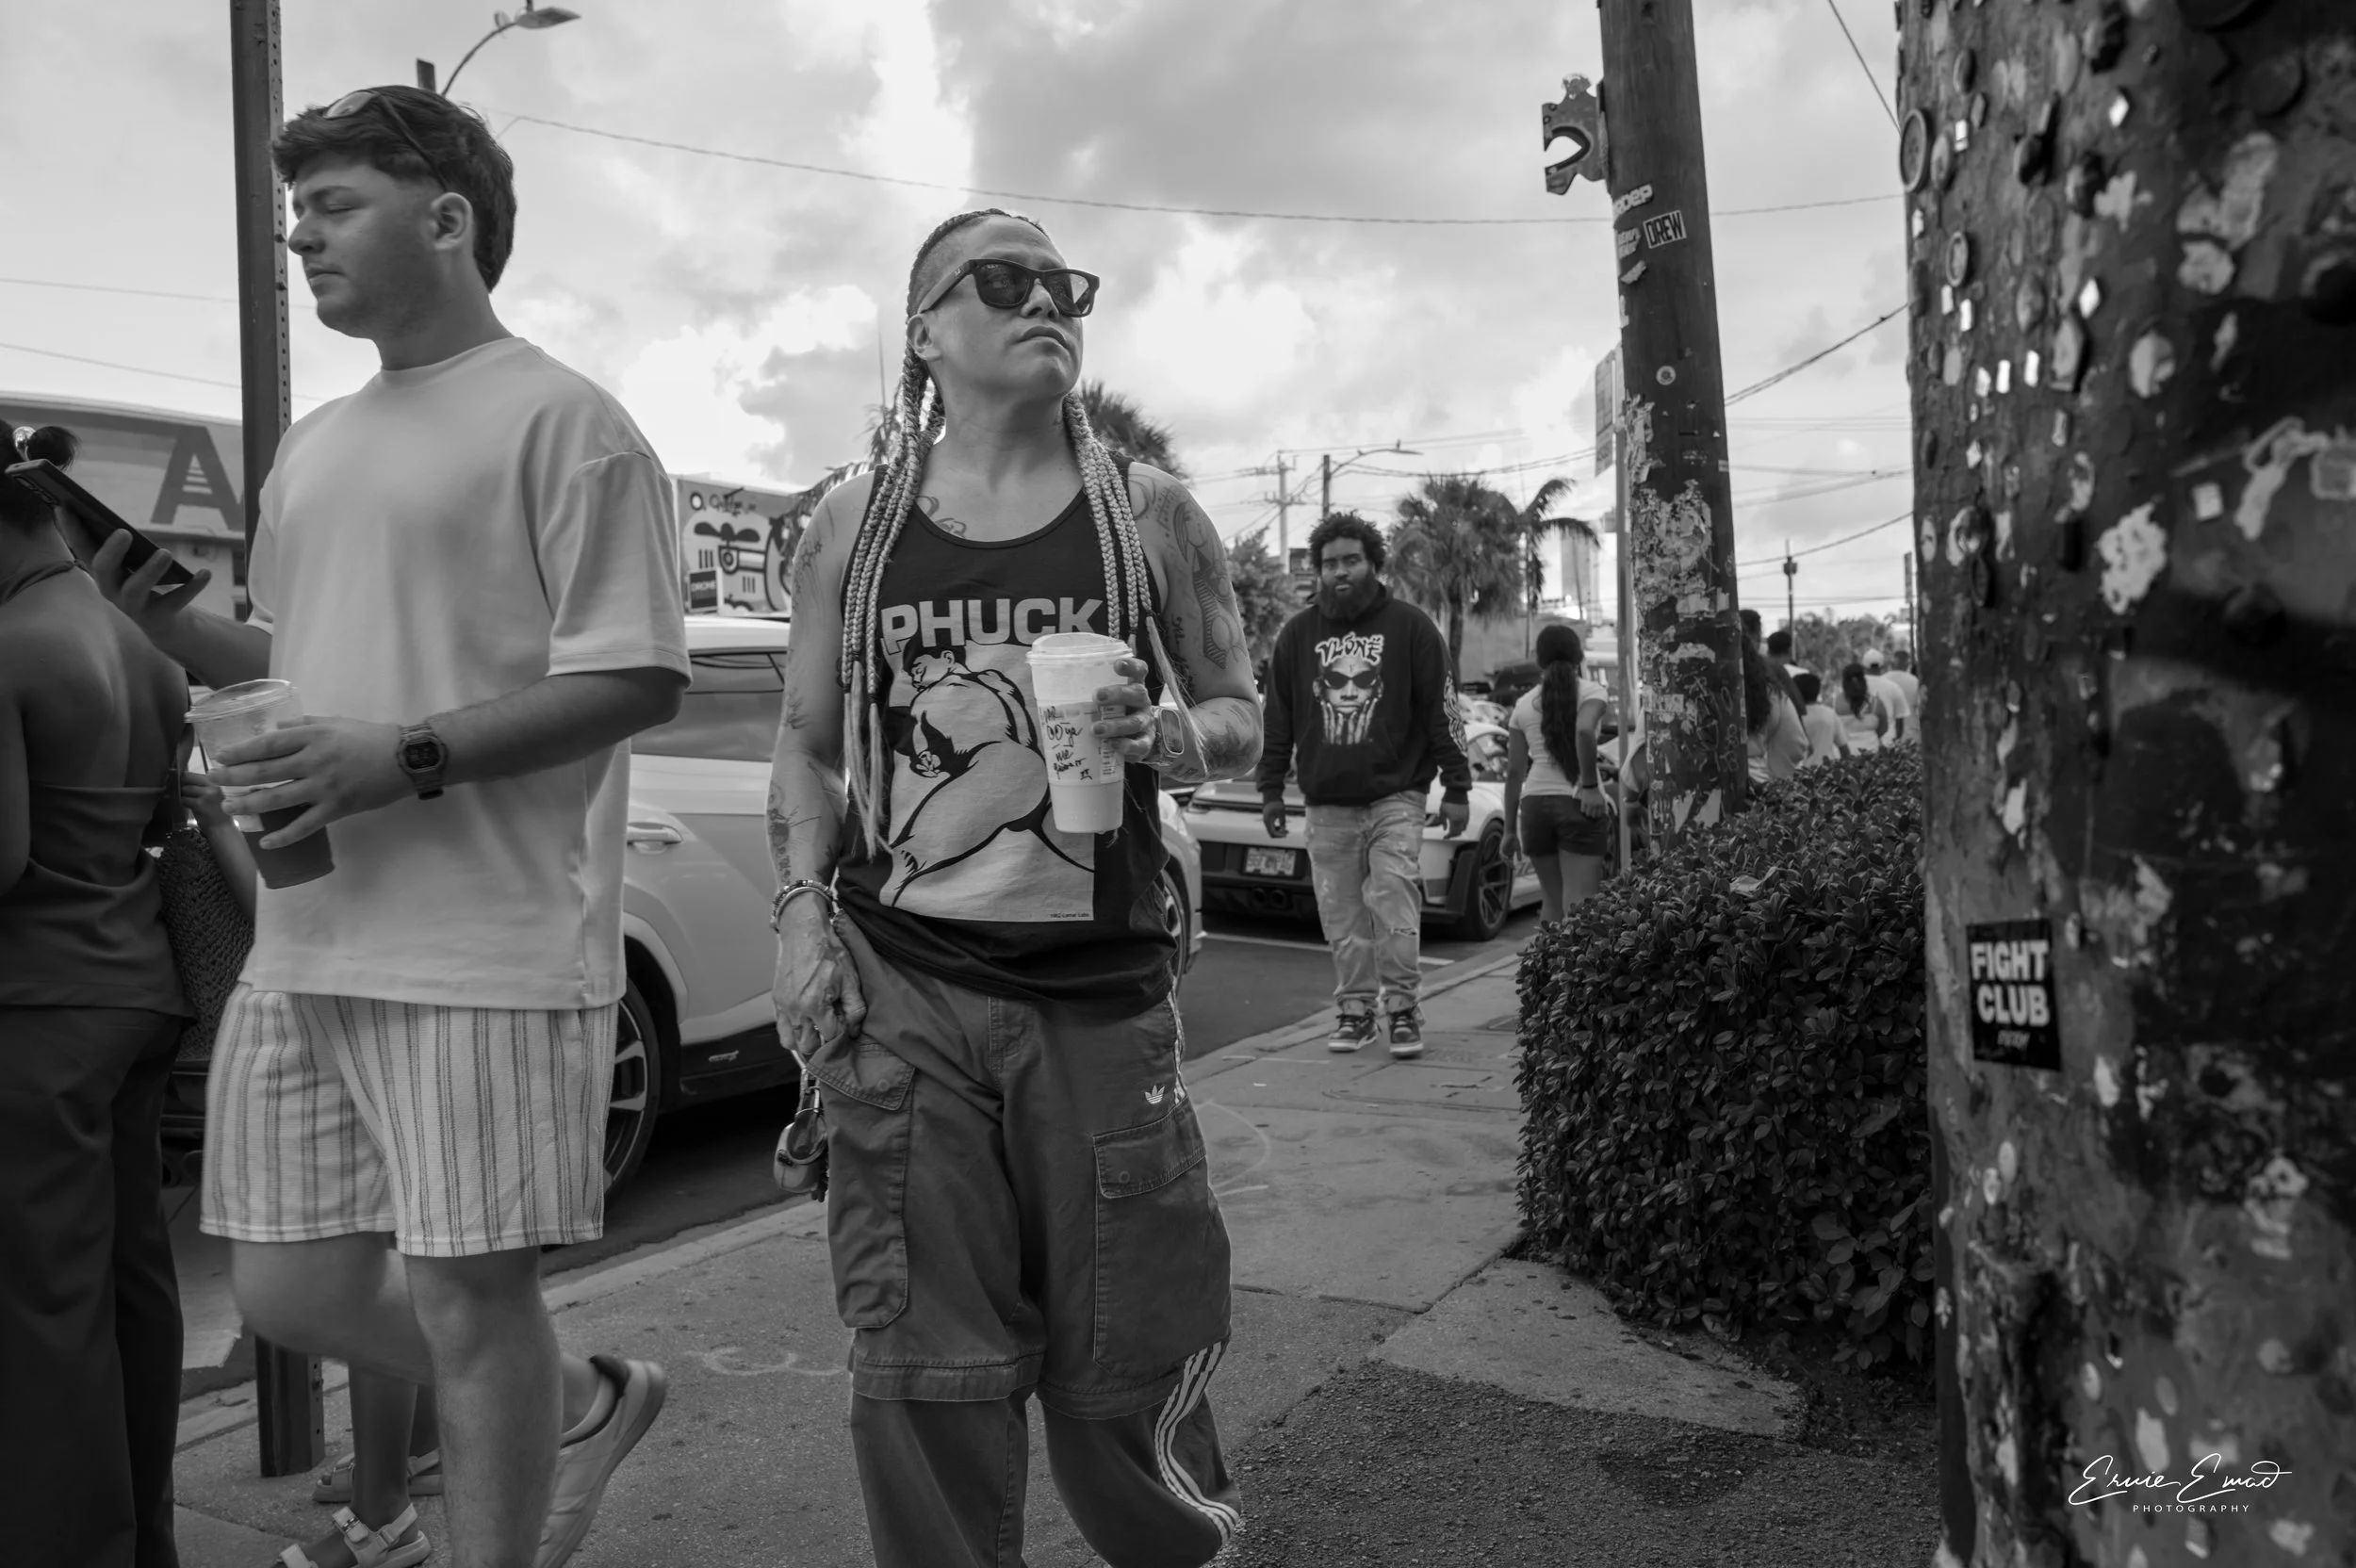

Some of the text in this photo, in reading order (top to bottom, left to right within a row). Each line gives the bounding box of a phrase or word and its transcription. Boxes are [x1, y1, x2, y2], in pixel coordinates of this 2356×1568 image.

[1645, 211, 1683, 246] DREW
[880, 596, 1103, 655] PHUCK
[1971, 939, 2050, 981] FIGHT
[1977, 983, 2051, 1027] CLUB
